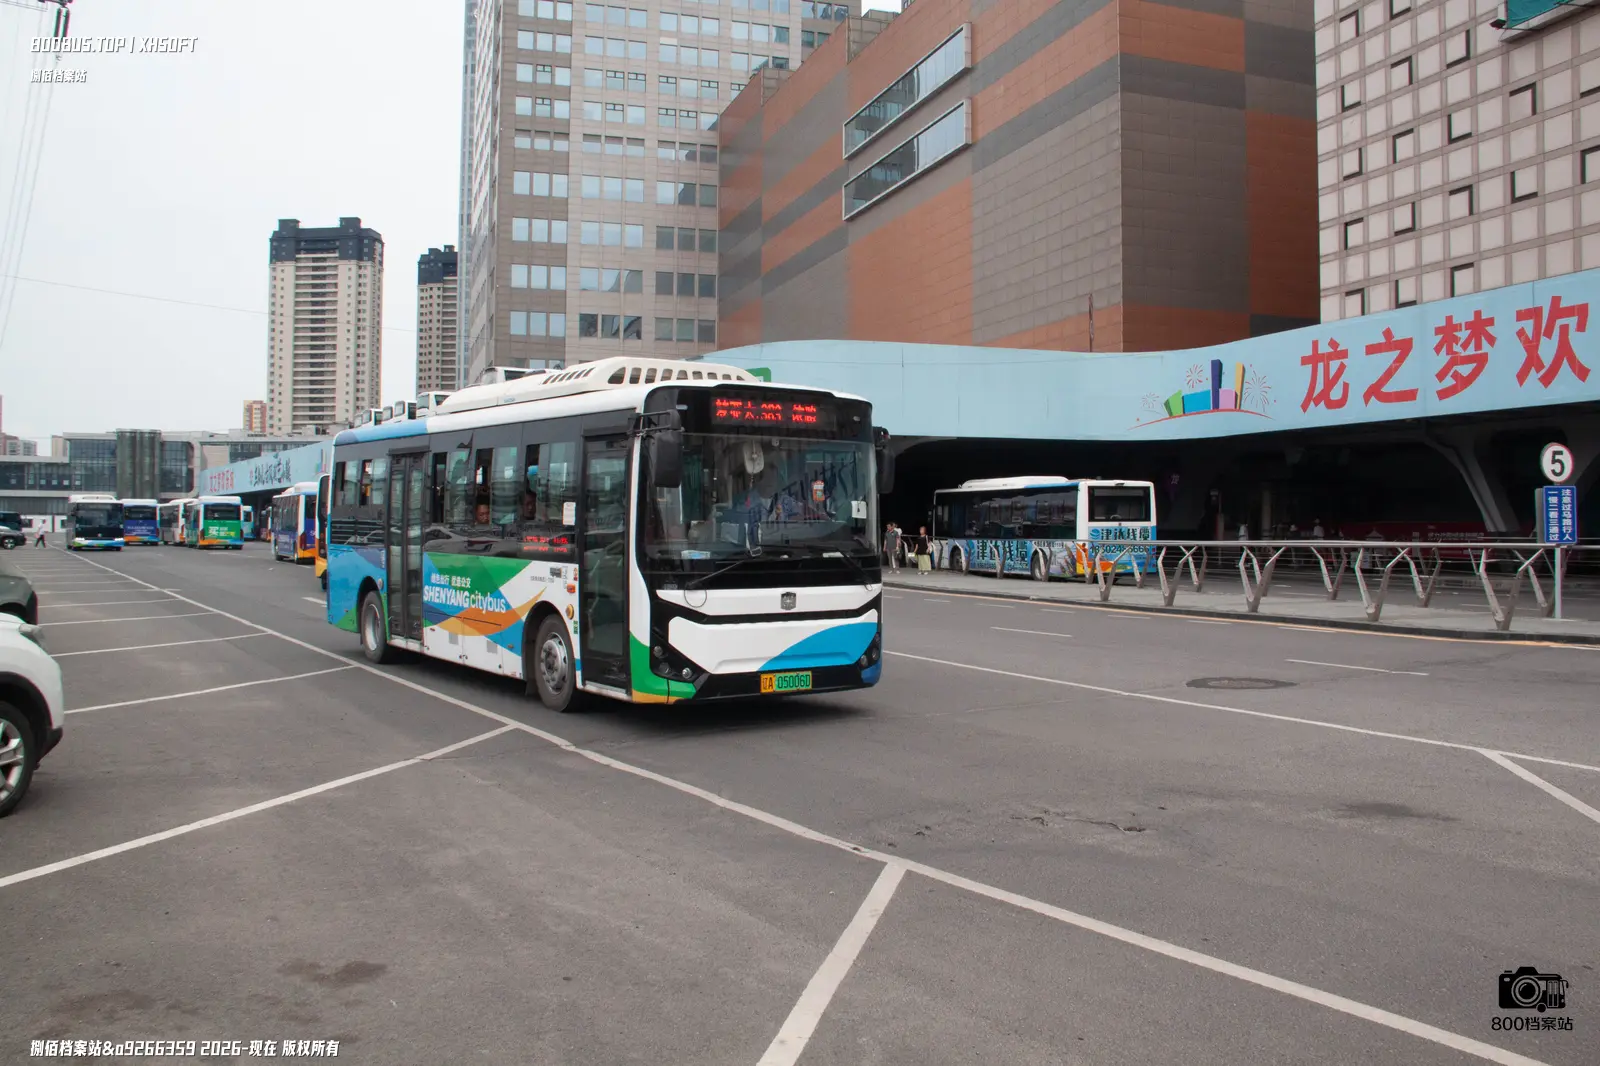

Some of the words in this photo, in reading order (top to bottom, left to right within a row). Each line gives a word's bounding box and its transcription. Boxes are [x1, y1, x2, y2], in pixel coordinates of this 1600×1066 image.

[1300, 296, 1591, 413] 龙之梦欢
[1550, 450, 1565, 477] 5
[1547, 490, 1559, 541] 一慢二看三通过
[1561, 489, 1573, 541] 注意过马路行人
[423, 585, 470, 608] SHENYANG
[470, 591, 507, 614] citybus
